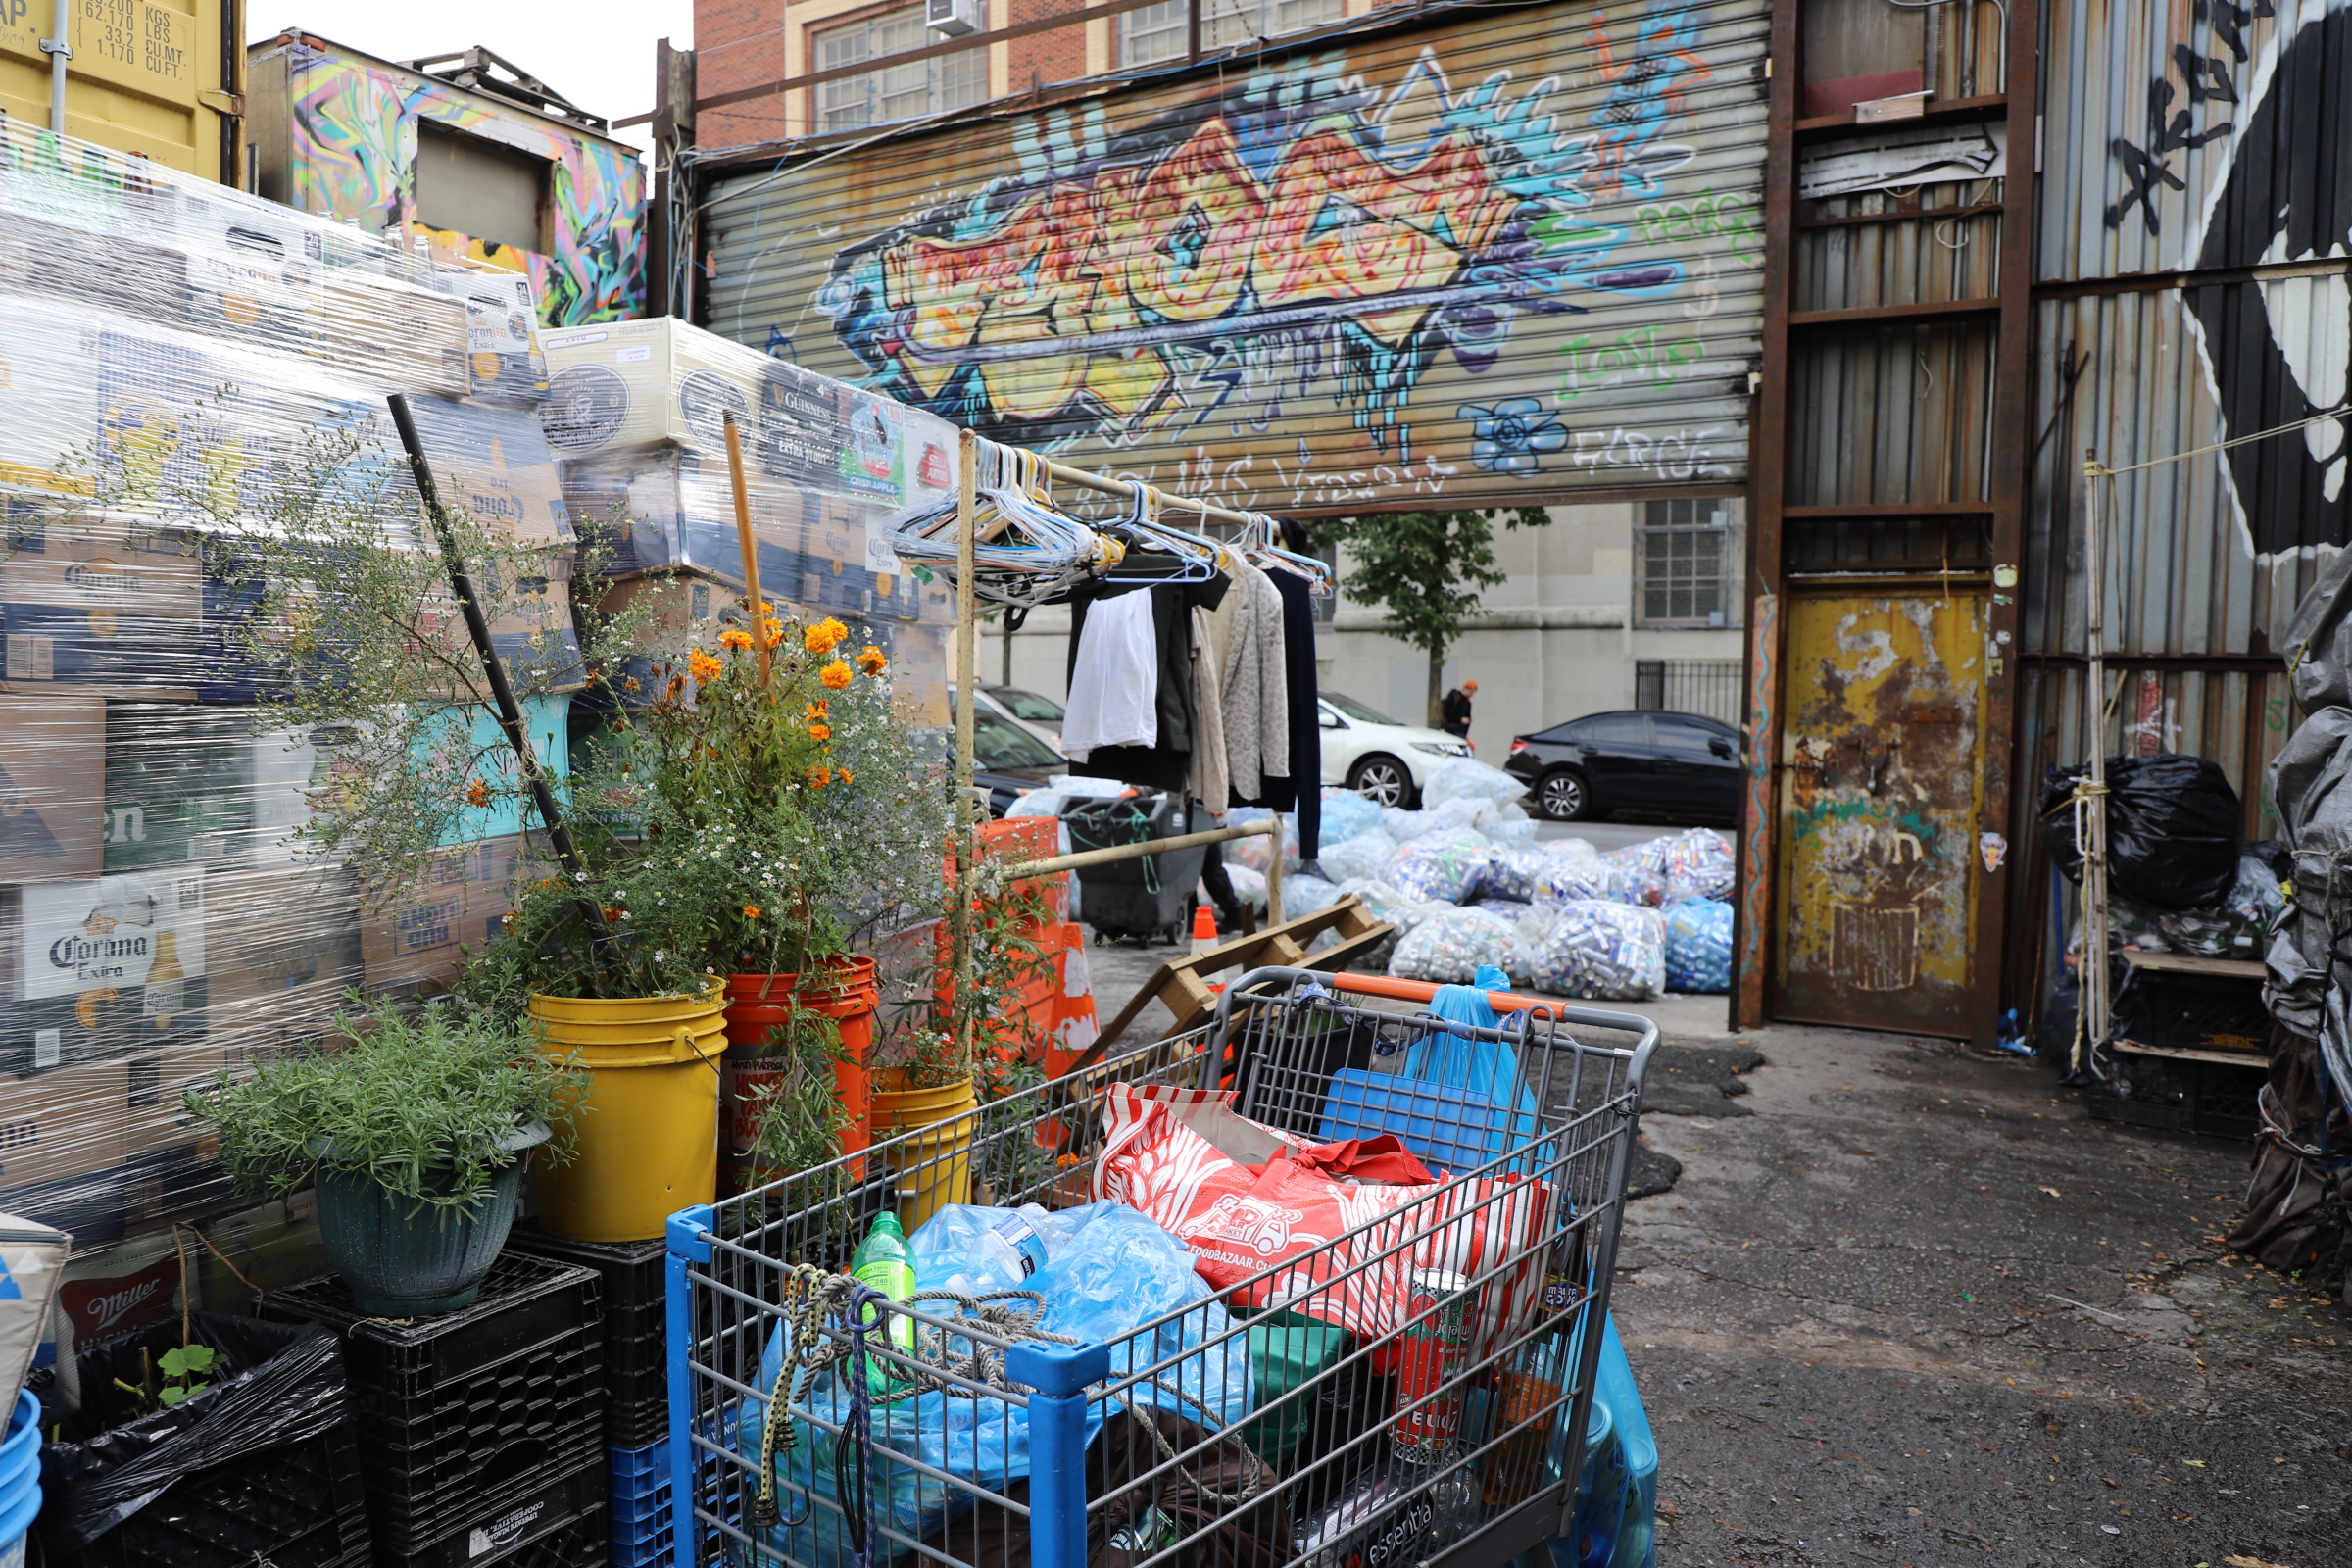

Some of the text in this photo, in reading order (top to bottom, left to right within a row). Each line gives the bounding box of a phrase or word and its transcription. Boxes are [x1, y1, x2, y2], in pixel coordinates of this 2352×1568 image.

[85, 1, 170, 44] 62.170 LBS
[145, 6, 171, 27] KGS
[97, 39, 183, 80] 1.170 CU.FT.
[105, 24, 186, 67] 33.2 CU.MT.
[467, 324, 507, 339] oronita
[585, 374, 610, 383] PREMIUM
[785, 392, 832, 421] GUINNESS
[778, 440, 828, 466] EXTRA STOUT
[398, 902, 456, 930] LIGHT
[408, 923, 449, 948] BUD
[49, 935, 148, 969] Corona
[77, 962, 123, 980] Extra
[88, 1277, 162, 1325] Miller
[1369, 1503, 1432, 1565] essentia
